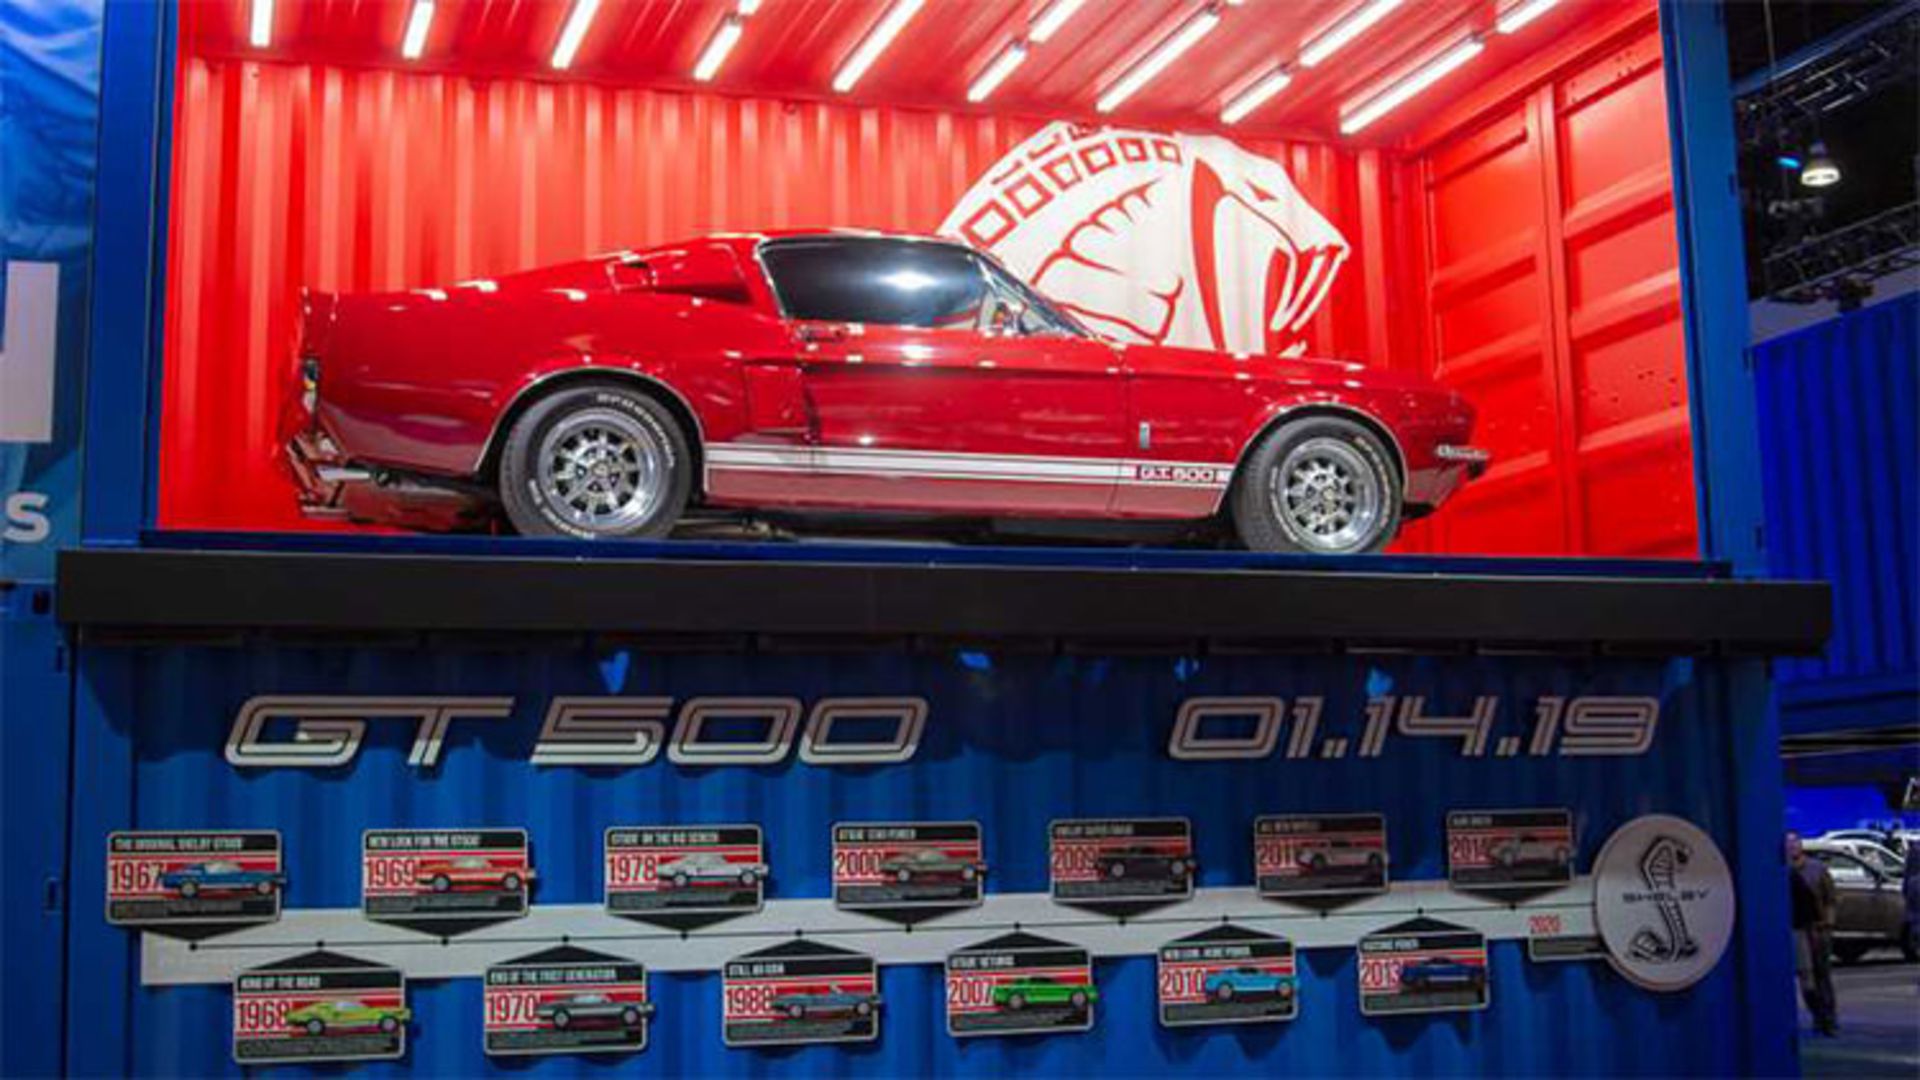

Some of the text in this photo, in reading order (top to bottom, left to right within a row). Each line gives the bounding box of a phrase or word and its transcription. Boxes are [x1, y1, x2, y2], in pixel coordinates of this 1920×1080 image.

[224, 696, 930, 767] GT 500
[1168, 696, 1661, 760] 01.14.19
[608, 854, 657, 882] 1978
[835, 850, 882, 877] 2000
[1258, 841, 1297, 868] 2011
[110, 861, 163, 890] 1967
[367, 859, 417, 886] 1969
[1160, 970, 1205, 997] 2010
[1361, 960, 1401, 989] 2013
[725, 986, 774, 1013] 1988
[949, 979, 994, 1005] 2007
[238, 1001, 290, 1030] 1968
[488, 994, 538, 1022] 1970
